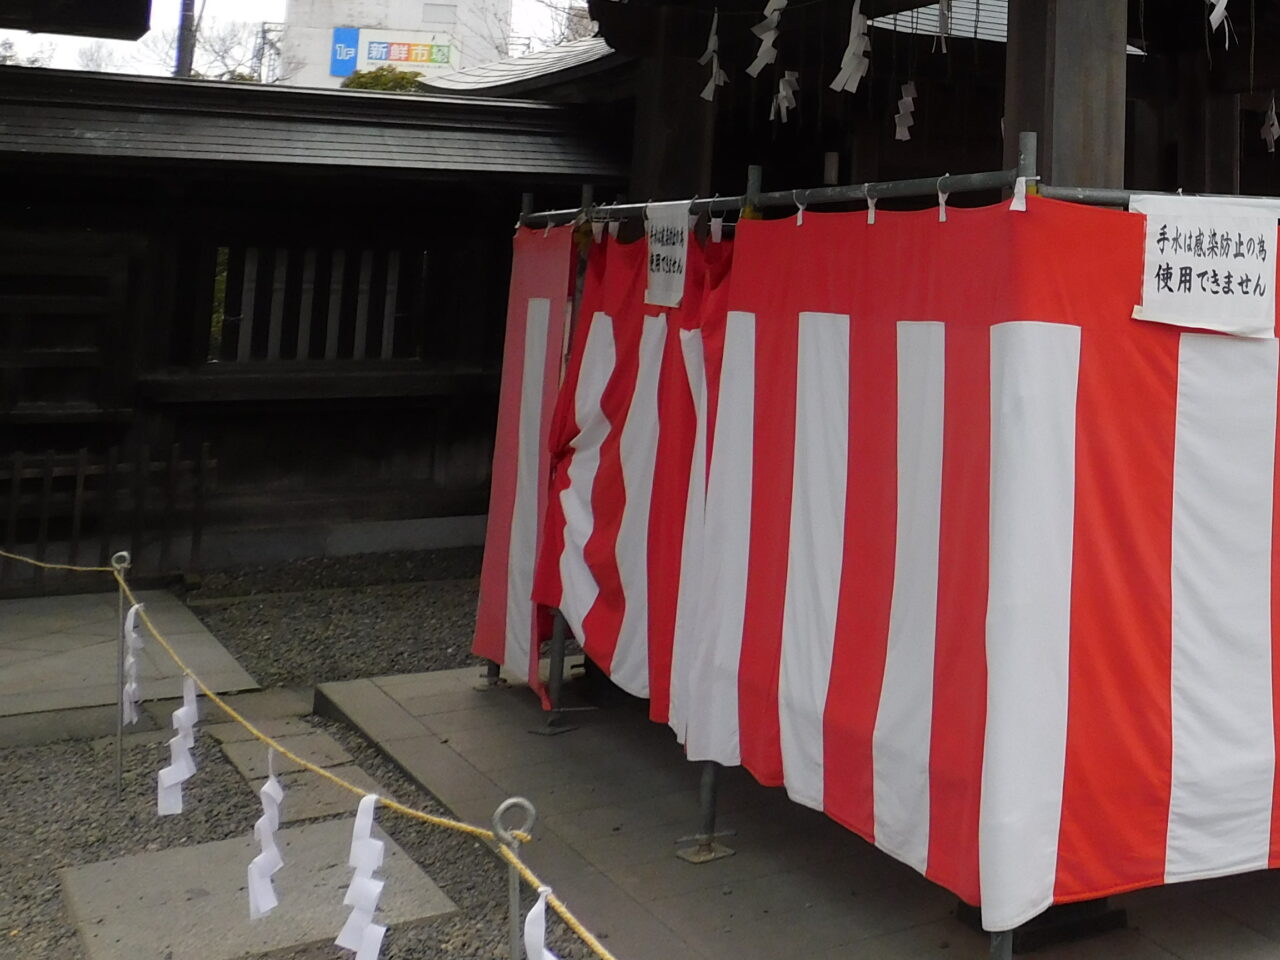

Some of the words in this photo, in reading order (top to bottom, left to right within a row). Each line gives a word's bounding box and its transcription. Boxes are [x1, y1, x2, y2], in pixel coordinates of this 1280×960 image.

[335, 43, 356, 60] 1F
[368, 42, 450, 63] 新鮮市場
[1156, 223, 1268, 263] 手水は感染防止の為
[1154, 263, 1267, 298] 使用できません
